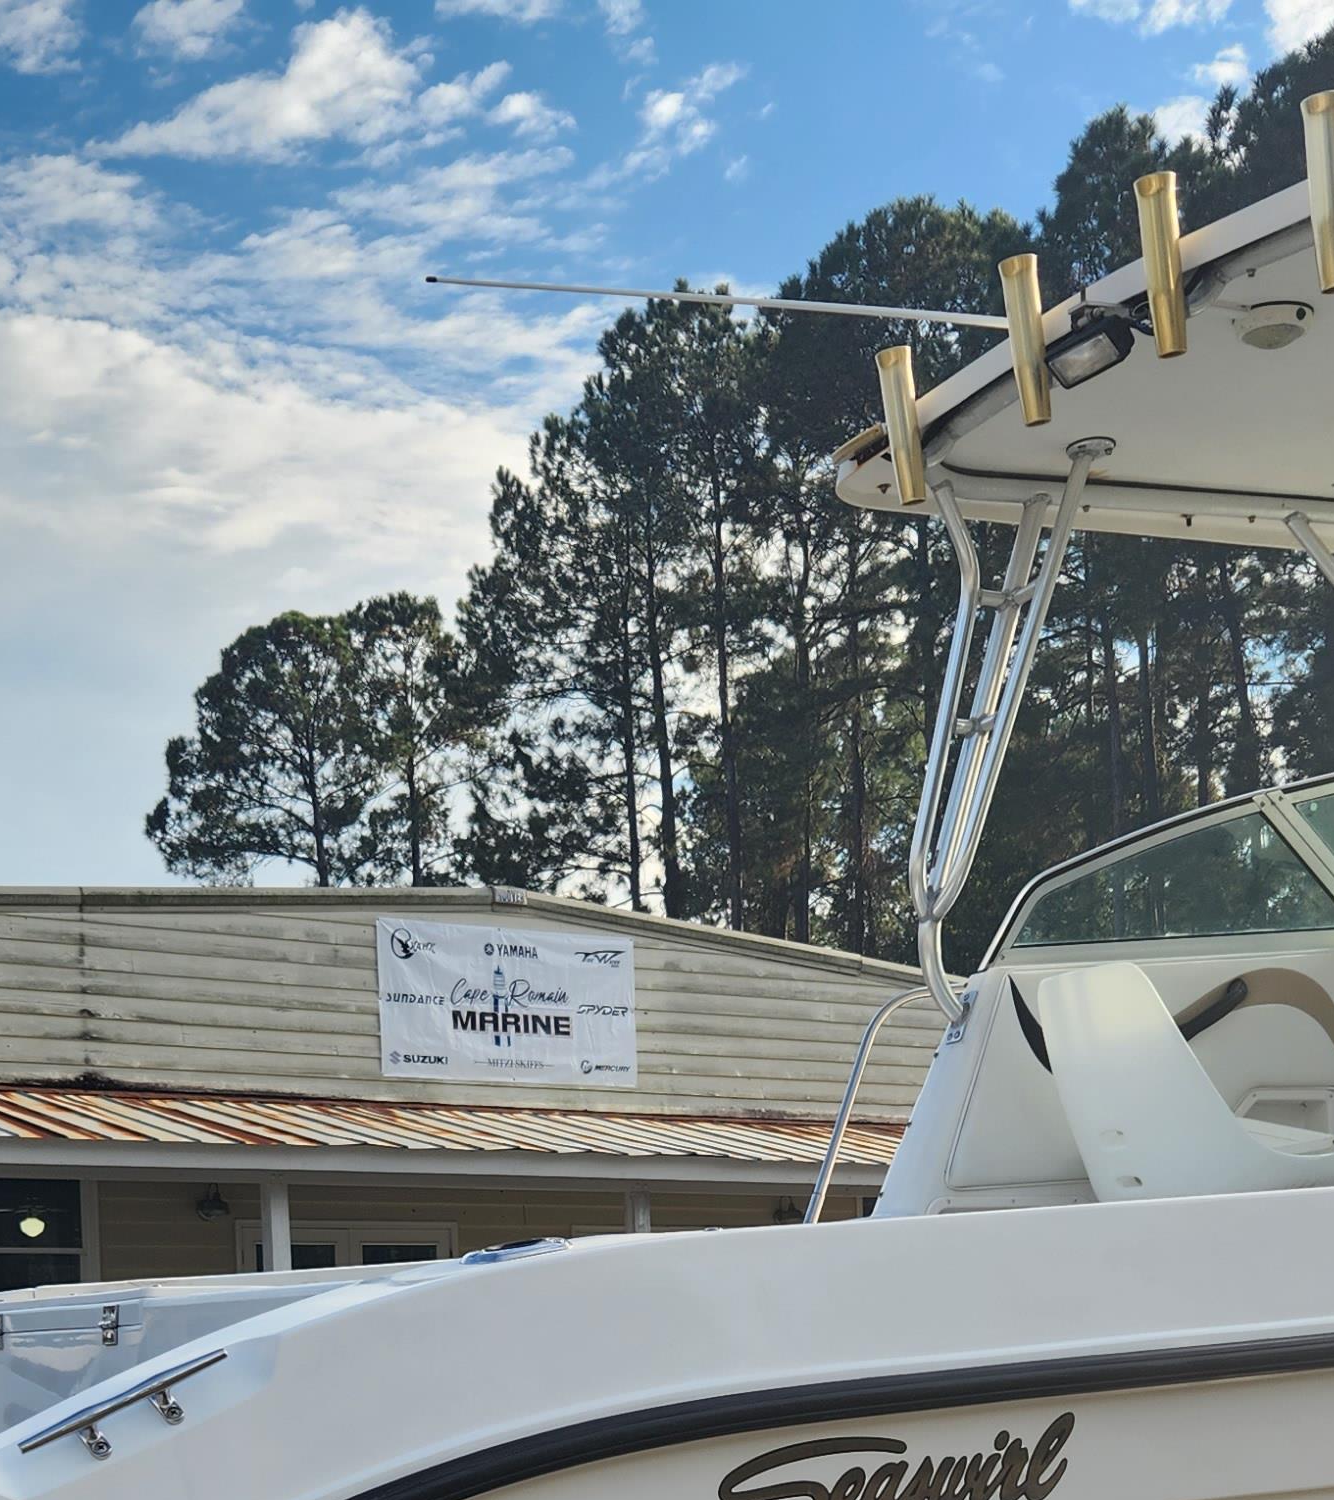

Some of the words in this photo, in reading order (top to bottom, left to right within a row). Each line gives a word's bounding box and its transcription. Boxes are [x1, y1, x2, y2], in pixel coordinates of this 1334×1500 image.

[496, 943, 538, 959] YAMAHA
[450, 978, 489, 1005] Cape
[576, 1004, 628, 1017] SPYDER
[452, 1010, 571, 1036] MARINE
[403, 1054, 449, 1065] SUZUKI
[594, 1064, 630, 1073] MERCURY
